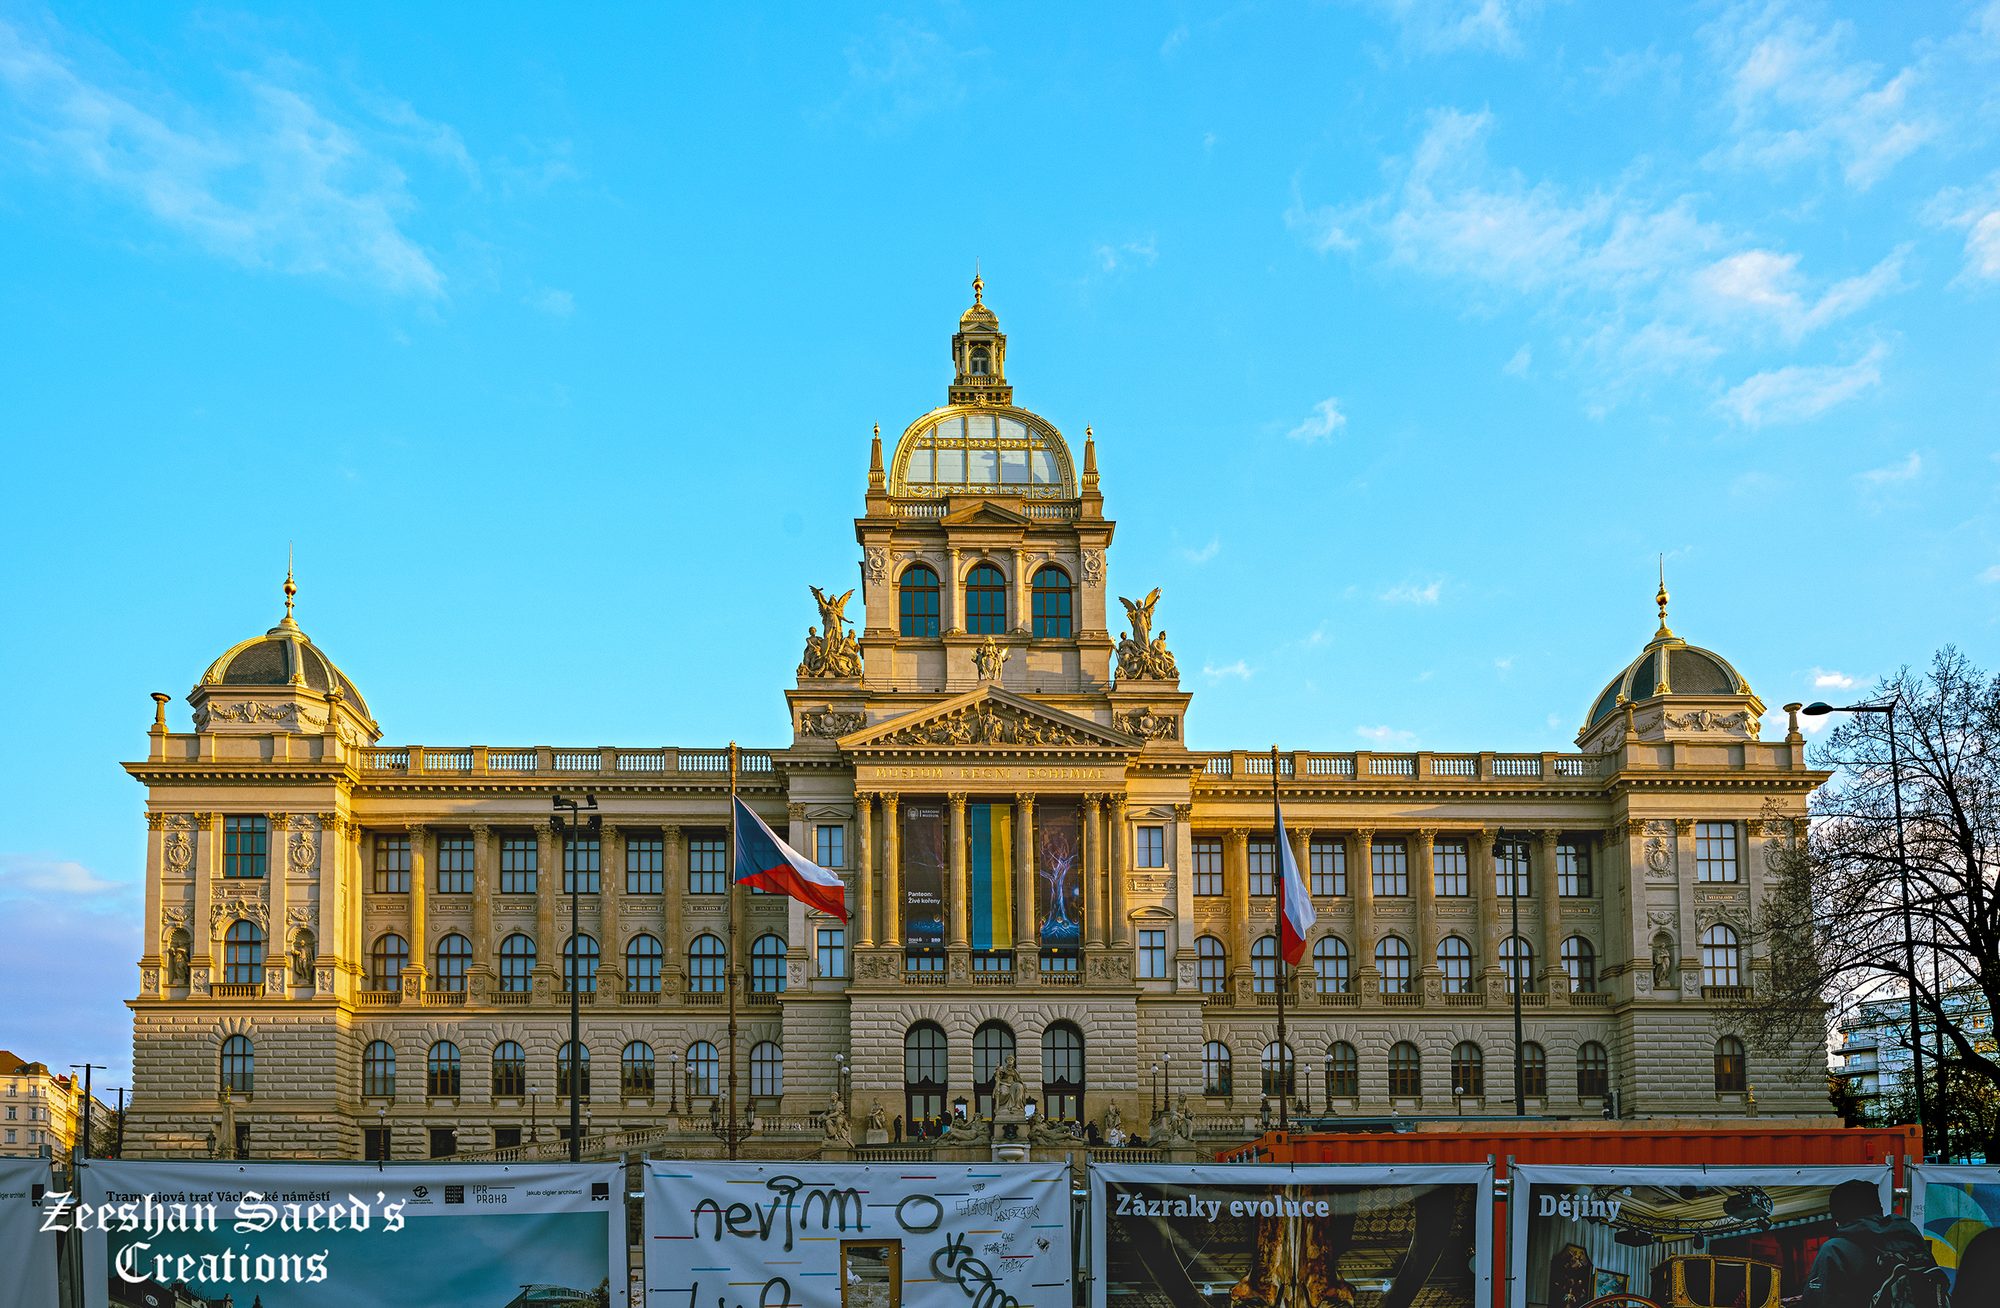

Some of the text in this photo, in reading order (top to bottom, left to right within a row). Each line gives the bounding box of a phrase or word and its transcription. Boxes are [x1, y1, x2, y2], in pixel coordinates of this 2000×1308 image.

[876, 768, 1106, 779] MUSEUM REGNI BOHEMIAE
[472, 1184, 488, 1195] IPR
[189, 1190, 213, 1202] trať
[282, 1191, 331, 1202] náměstí
[1115, 1192, 1330, 1223] Zázraky evoluce
[1538, 1193, 1622, 1223] Dějiny
